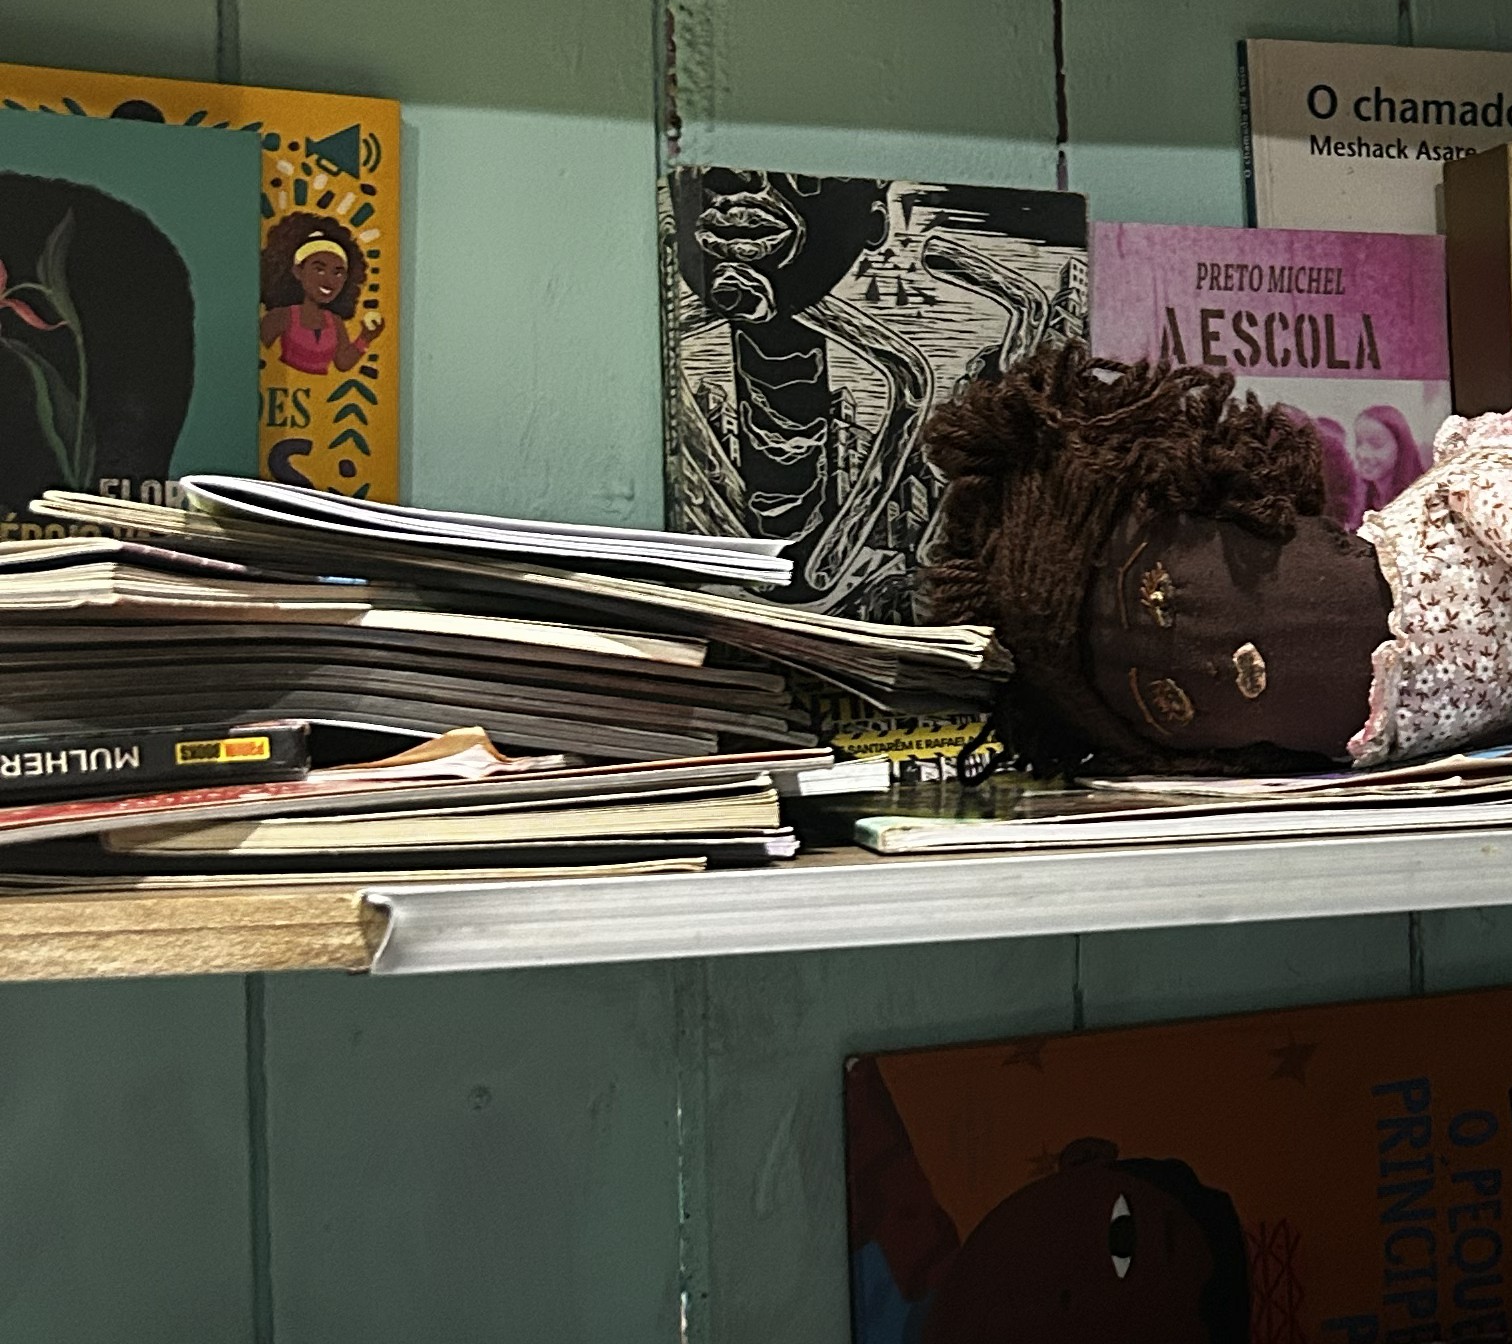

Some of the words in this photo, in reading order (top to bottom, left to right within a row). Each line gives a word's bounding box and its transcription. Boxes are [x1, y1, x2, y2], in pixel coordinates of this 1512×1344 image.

[1308, 84, 1338, 120] O
[1310, 134, 1408, 160] Meshack
[1416, 140, 1477, 161] Asare
[1196, 263, 1263, 292] PRETO
[1267, 266, 1345, 296] MICHEL
[1161, 307, 1187, 365] A
[1200, 308, 1381, 370] ESCOLA
[261, 387, 312, 429] ES
[1448, 1110, 1499, 1148] O
